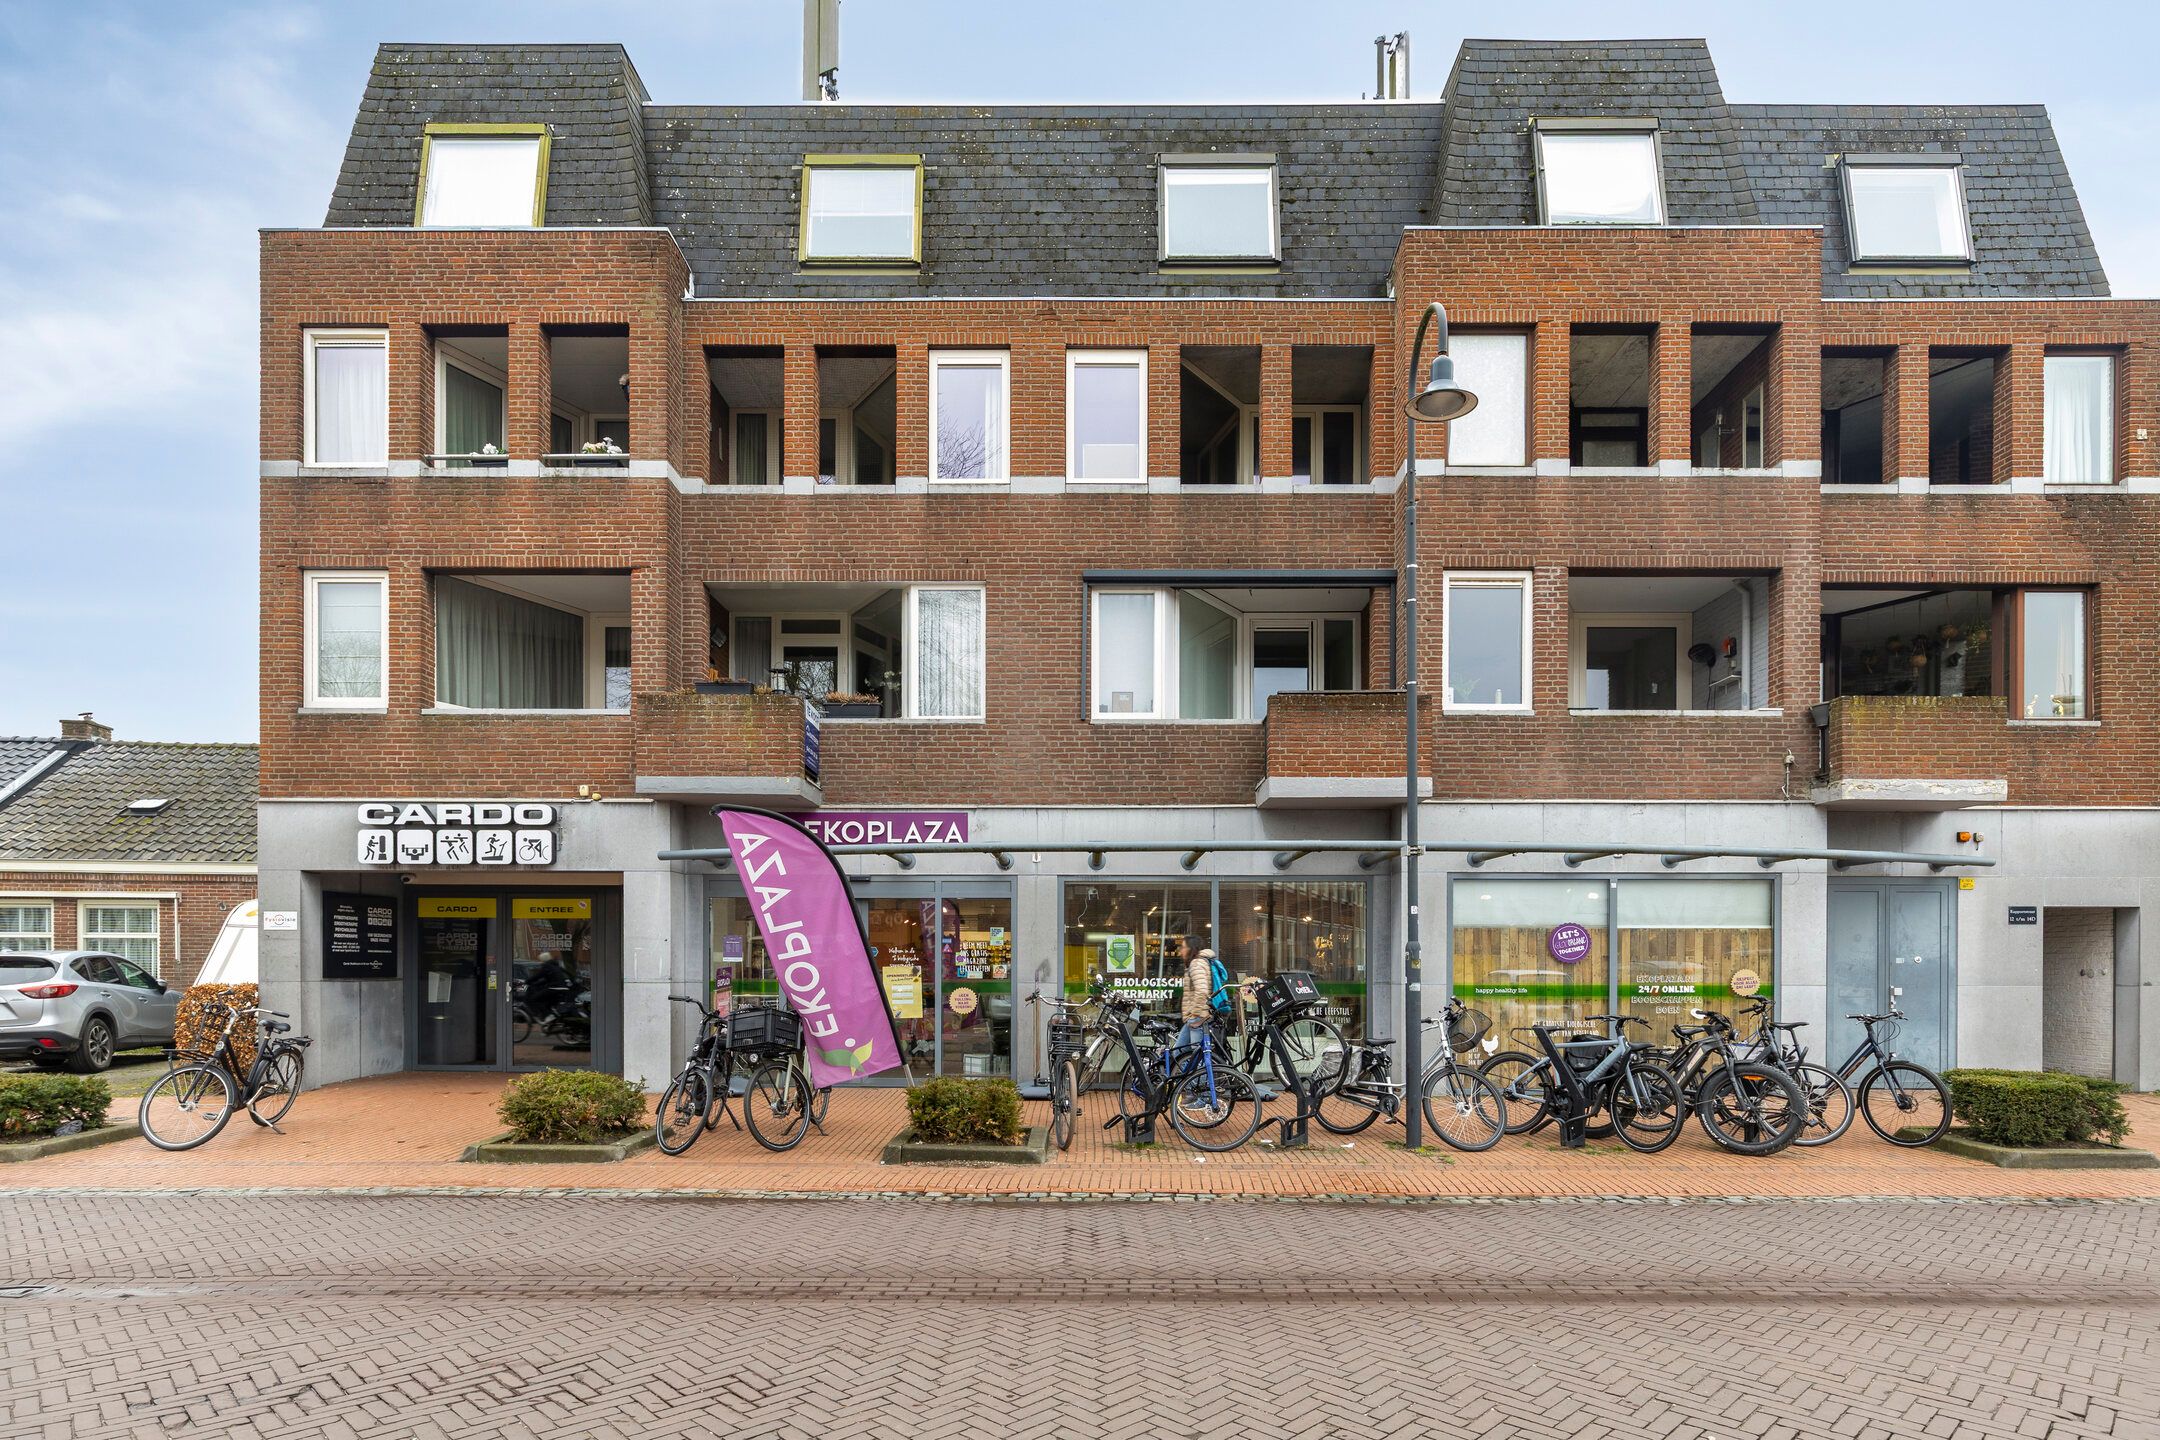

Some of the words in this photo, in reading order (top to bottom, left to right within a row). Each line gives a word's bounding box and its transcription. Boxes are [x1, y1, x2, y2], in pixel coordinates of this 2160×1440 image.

[358, 803, 553, 825] CARDO
[804, 820, 964, 843] EKOPLAZA
[367, 907, 393, 915] CARDO
[1557, 929, 1580, 940] LET'S
[437, 938, 478, 946] FYSIO
[1558, 945, 1585, 954] TOGETHER
[1114, 977, 1185, 987] BIOLOGISCH
[1638, 985, 1660, 993] 24/7
[1661, 985, 1696, 993] ONLINE
[1631, 995, 1703, 1004] BOODSCHAPPEN
[1655, 1006, 1680, 1014] DOEN
